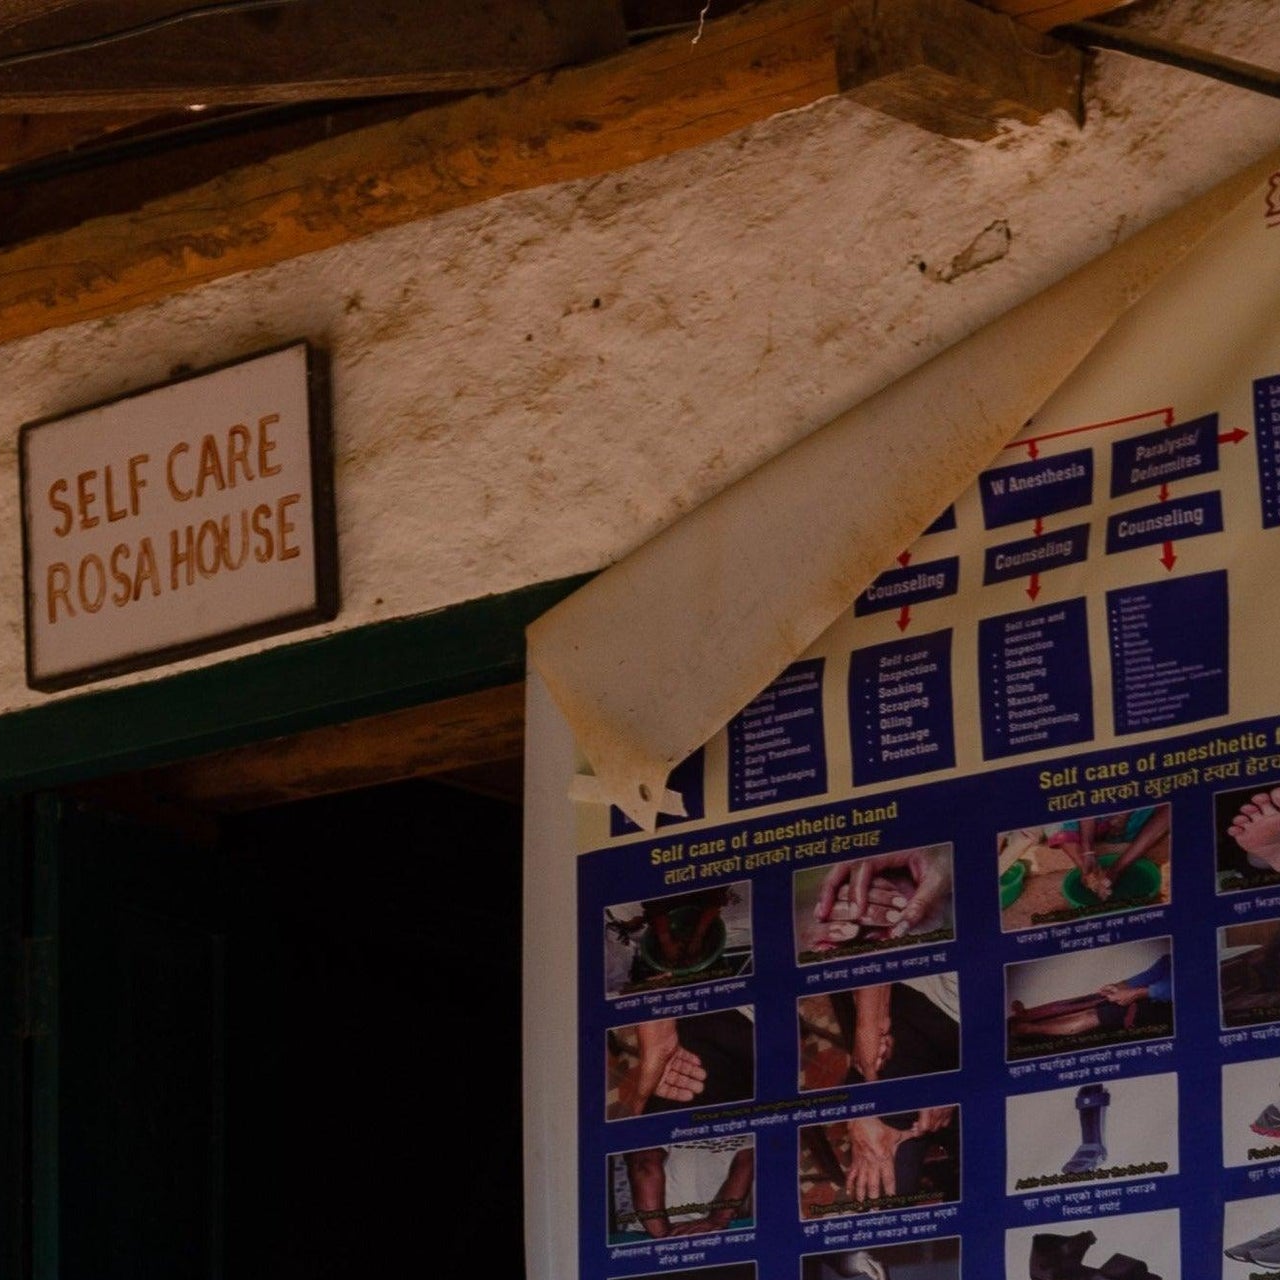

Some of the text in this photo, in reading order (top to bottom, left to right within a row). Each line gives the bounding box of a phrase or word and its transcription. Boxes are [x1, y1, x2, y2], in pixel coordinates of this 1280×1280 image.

[1134, 427, 1200, 462] Paralysis/
[48, 413, 283, 538] SELF CARE
[990, 463, 1086, 497] W Anesthesia
[1116, 504, 1205, 539] Counseling
[46, 493, 301, 625] ROSA HOUSE
[994, 536, 1075, 571] Counseling
[866, 571, 946, 602] Counseling
[1004, 621, 1024, 633] Self
[1025, 617, 1046, 628] care
[879, 649, 930, 668] Self care
[1004, 640, 1055, 657] Inspection
[878, 661, 938, 683] Inspection
[1004, 655, 1044, 669] Soaking
[878, 680, 924, 699] Soaking
[1006, 693, 1050, 707] Massage
[879, 696, 930, 715] Scraping
[1007, 704, 1057, 720] Protection
[879, 714, 913, 729] Oiling
[880, 727, 930, 746] Massage
[880, 741, 939, 762] Protection
[1039, 769, 1078, 790] Self
[1084, 761, 1129, 782] care
[1136, 752, 1156, 771] of
[1163, 735, 1268, 767] anesthetic
[1047, 787, 1086, 812] लाटो
[1090, 780, 1140, 805] भएको
[649, 801, 898, 866] Self care of anesthetic hand
[663, 863, 697, 886] लाटो
[700, 854, 742, 879] भएको
